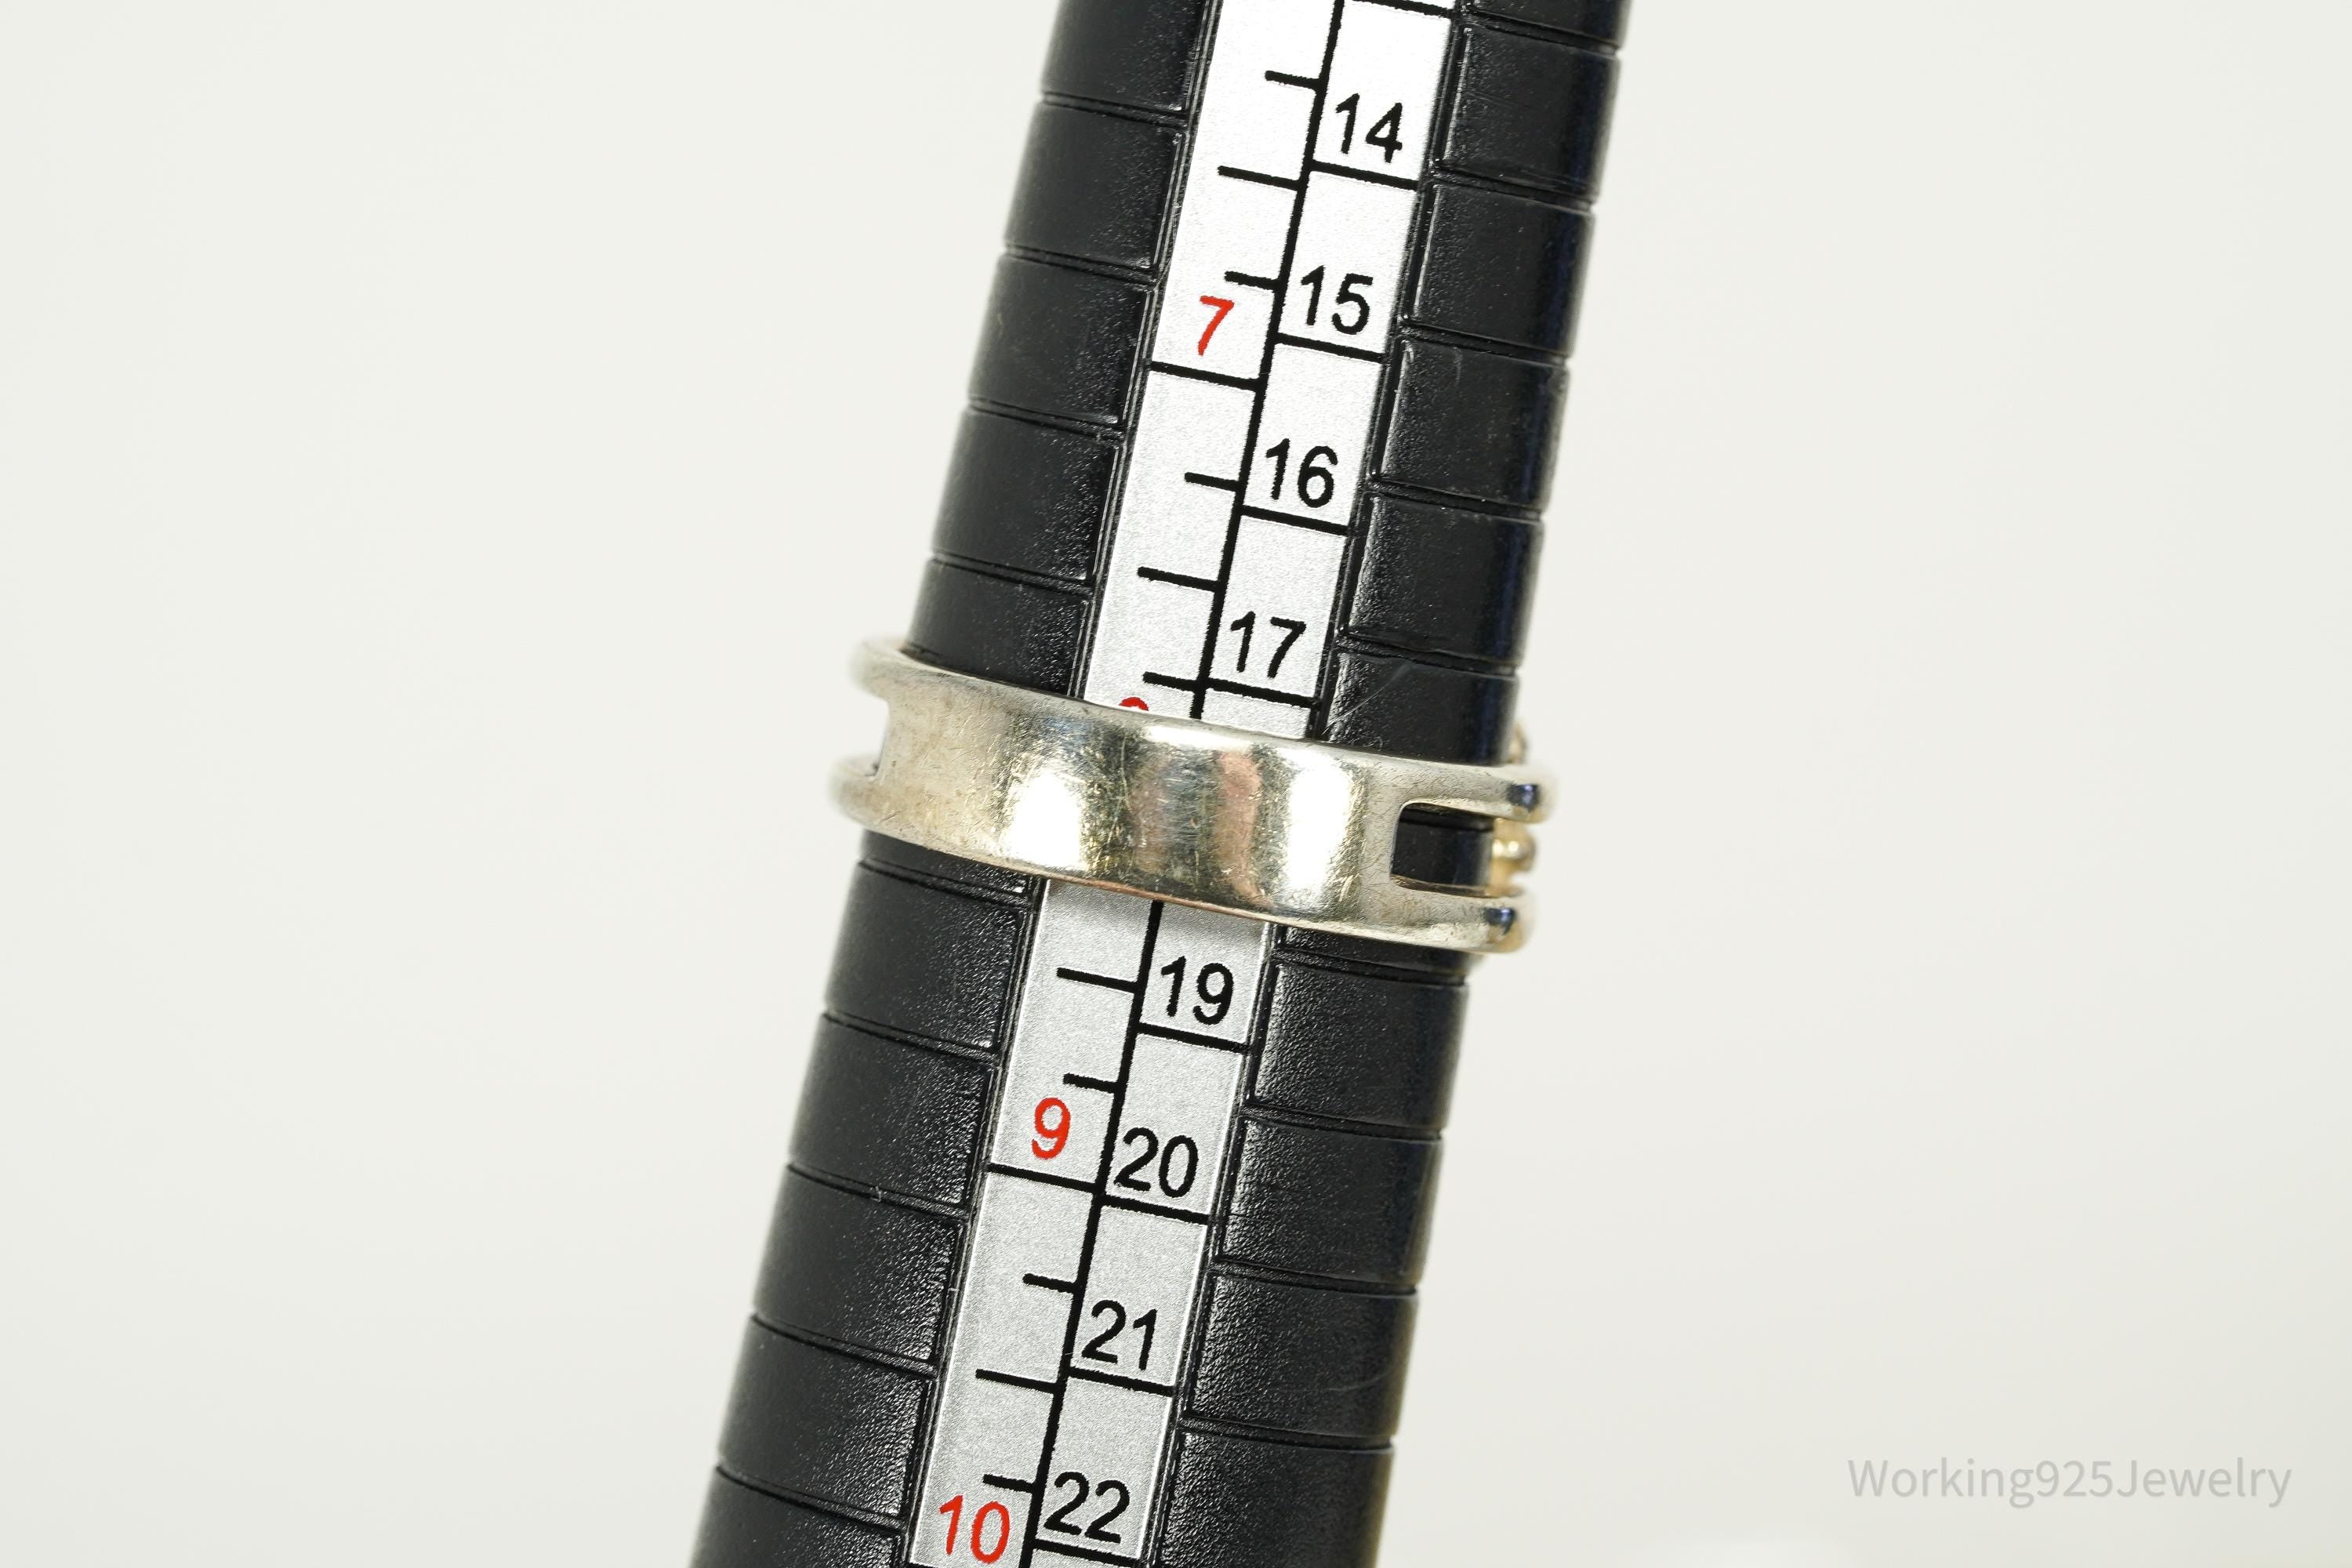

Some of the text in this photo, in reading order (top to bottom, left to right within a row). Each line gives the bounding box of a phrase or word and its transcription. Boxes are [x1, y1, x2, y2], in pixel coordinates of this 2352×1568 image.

[1335, 93, 1403, 164] 14
[1197, 296, 1235, 356] 7
[1301, 265, 1374, 336] 15
[1265, 437, 1338, 509] 16
[1229, 611, 1307, 679] 17
[1160, 955, 1236, 1026] 19
[1031, 1097, 1071, 1160] 9
[1113, 1127, 1199, 1199] 20
[1081, 1299, 1158, 1371] 21
[939, 1494, 1011, 1564] 10
[1044, 1471, 1130, 1544] 22
